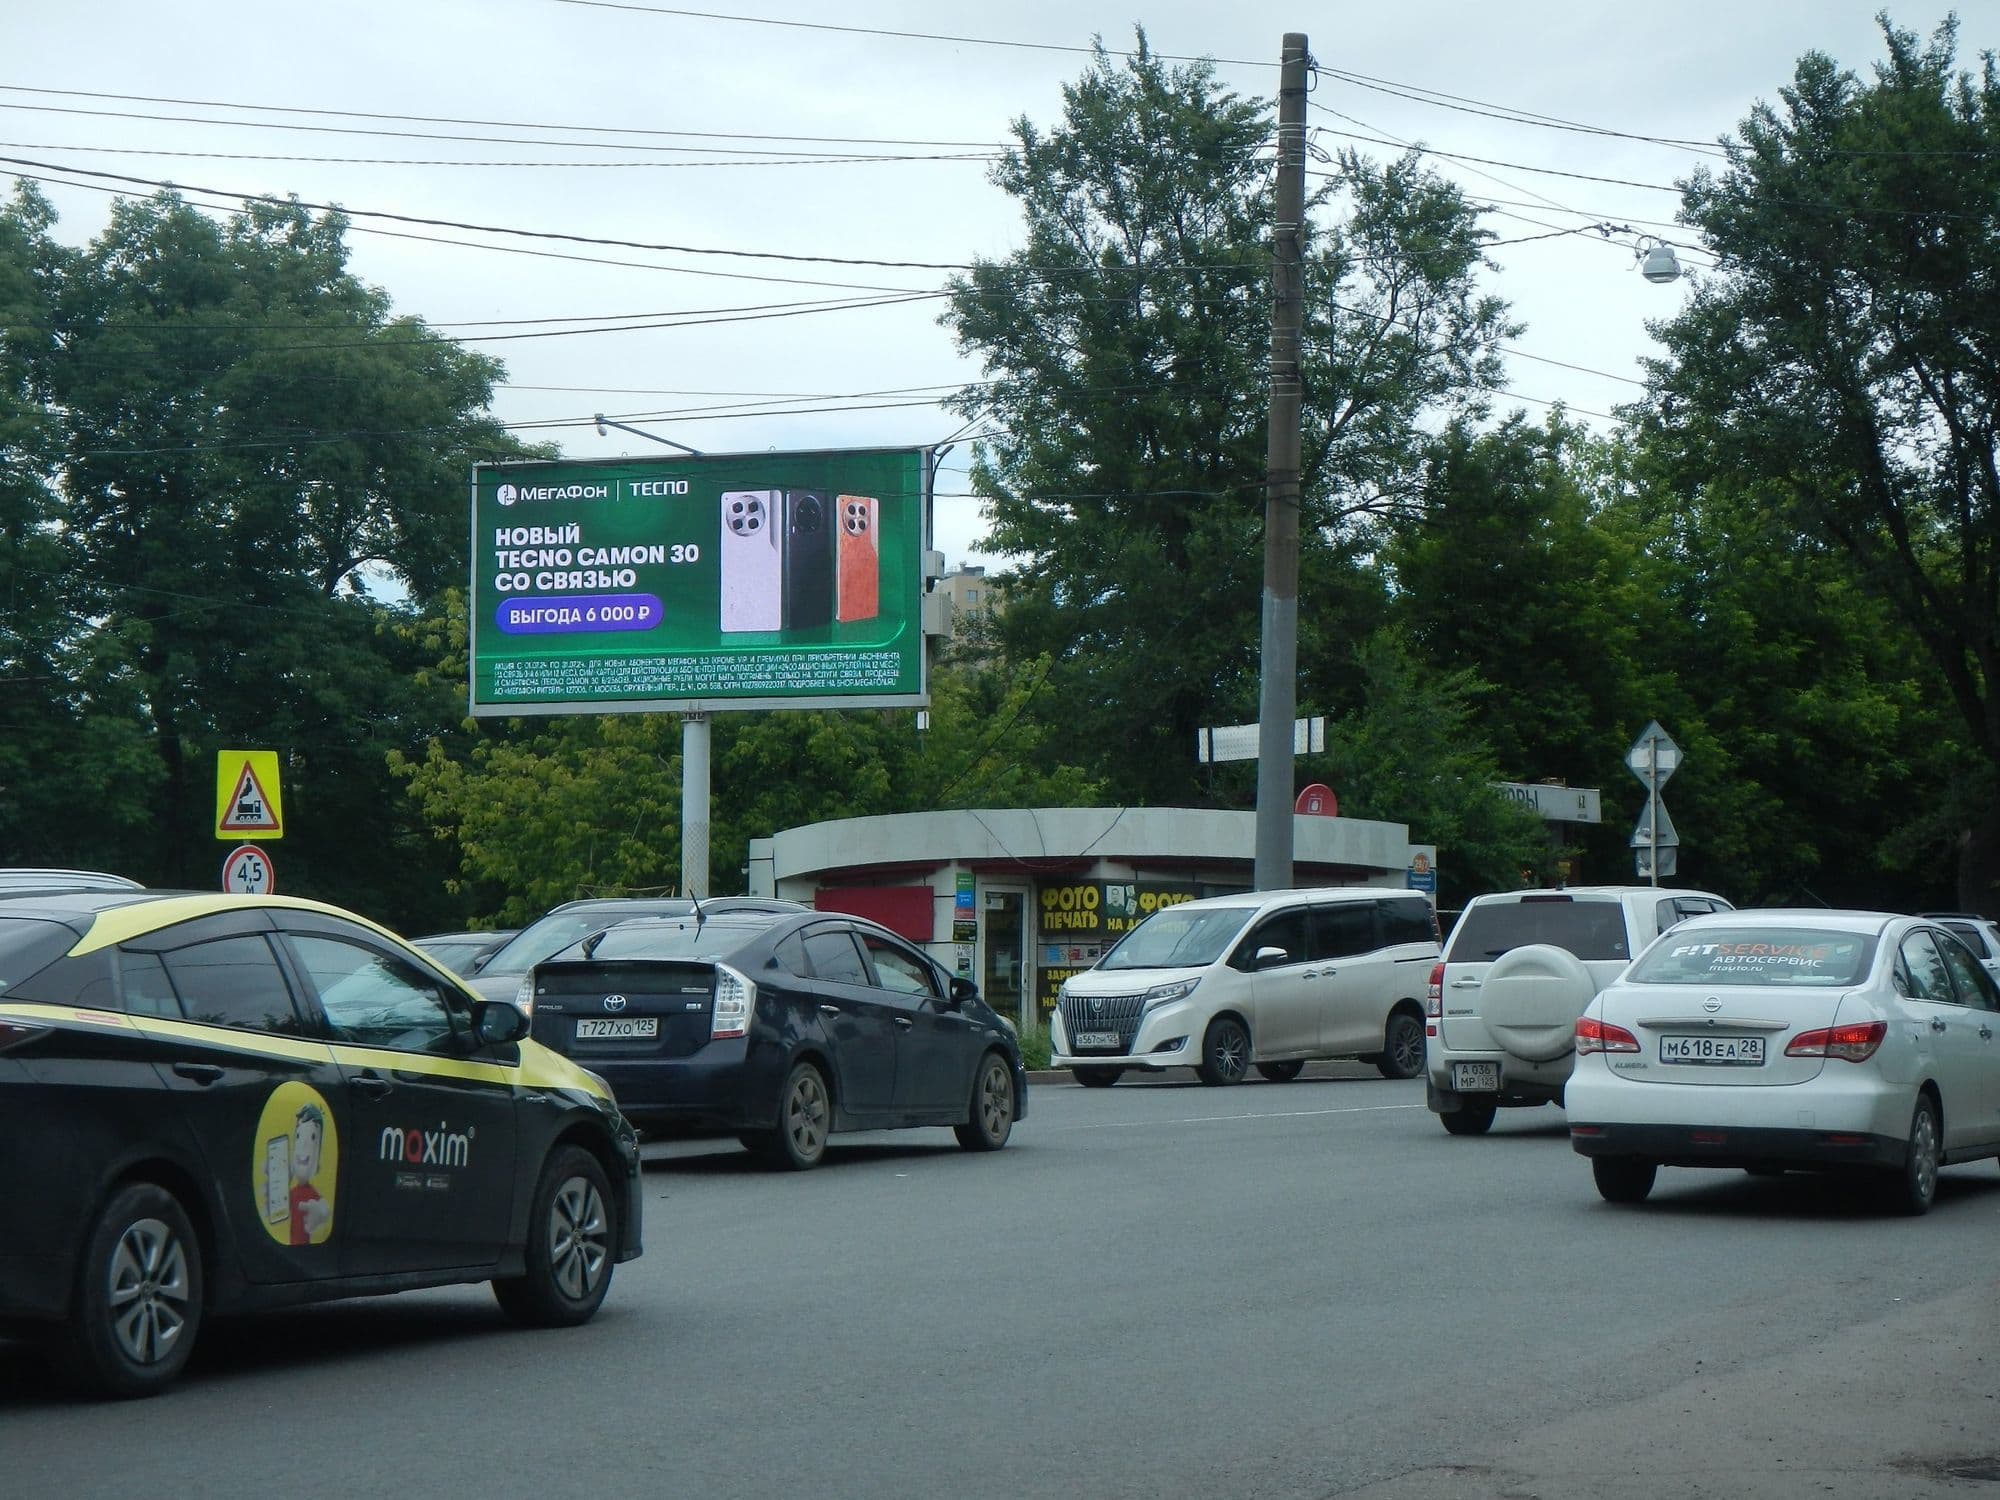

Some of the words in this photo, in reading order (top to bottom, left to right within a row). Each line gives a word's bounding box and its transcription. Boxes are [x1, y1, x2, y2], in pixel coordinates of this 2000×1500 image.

[495, 522, 580, 546] НОВЫЙ
[495, 549, 572, 568] TECNO
[577, 545, 664, 566] CAMON
[670, 543, 699, 563] 30
[494, 572, 530, 591] СО
[535, 568, 636, 590] СВЯЗЬЮ
[510, 608, 581, 625] ВЫГОДА
[585, 607, 596, 622] 6
[600, 606, 634, 621] 000
[237, 862, 262, 884] 4,5
[1041, 886, 1099, 911] ФОТО
[1044, 911, 1098, 929] ПЕЧАТЬ
[1107, 918, 1124, 930] НА
[1712, 956, 1824, 968] АВТОСЕРВИС
[1741, 1040, 1758, 1053] 28
[380, 1120, 468, 1167] maxim
